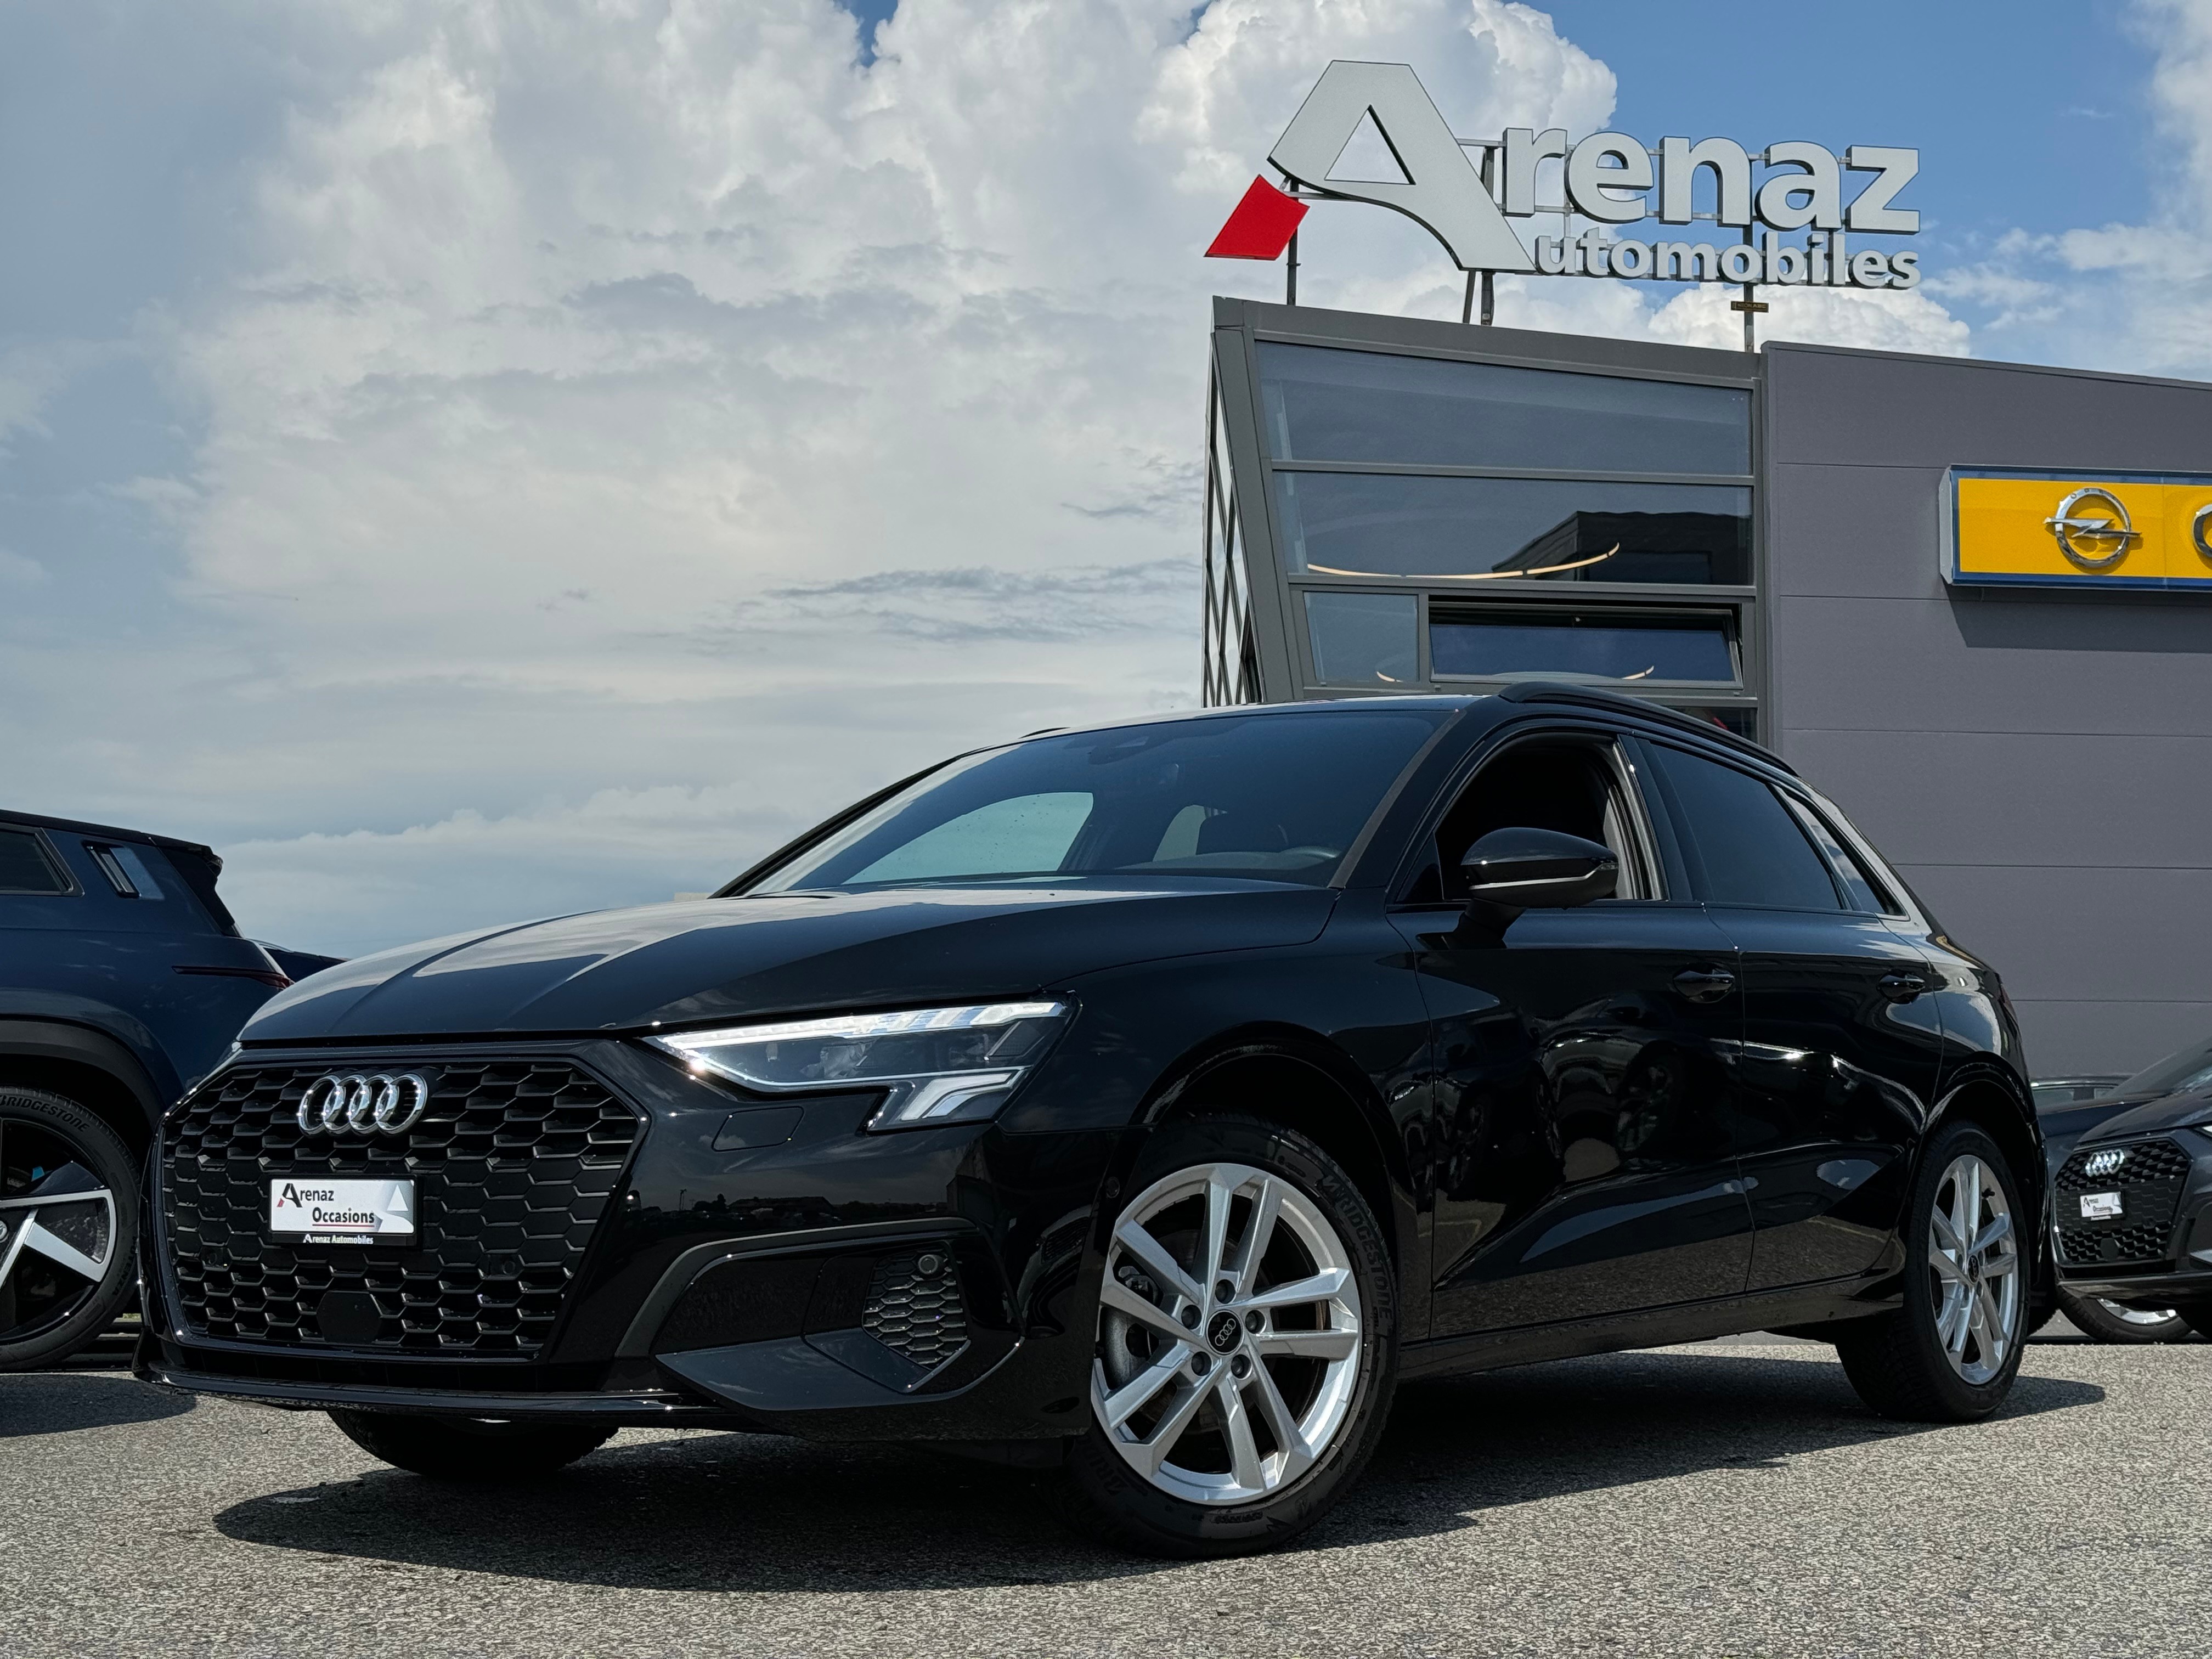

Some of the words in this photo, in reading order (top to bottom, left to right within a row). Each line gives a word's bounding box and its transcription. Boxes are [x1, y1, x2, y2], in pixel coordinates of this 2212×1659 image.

[1269, 60, 1920, 271] Arenaz
[282, 1183, 334, 1207] Arenaz
[312, 1207, 375, 1223] Occasions
[303, 1233, 330, 1244] Arenaz
[331, 1234, 374, 1245] Automobiles
